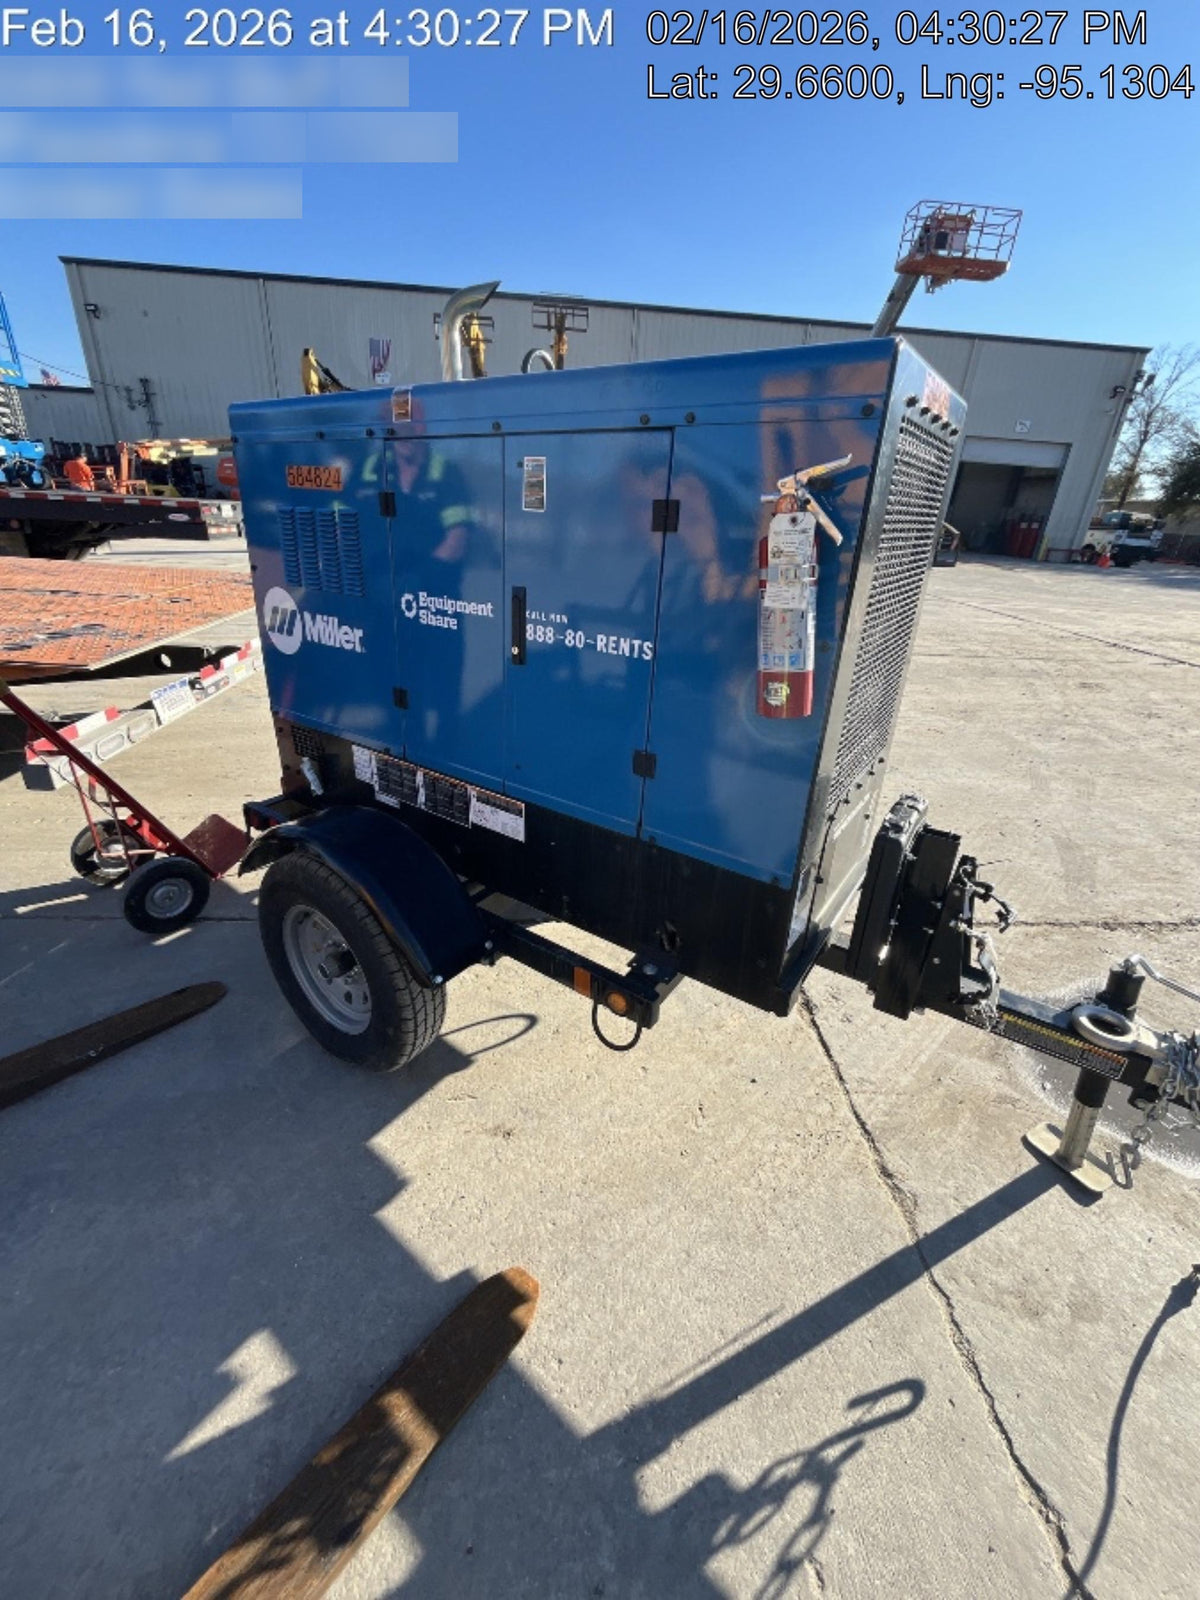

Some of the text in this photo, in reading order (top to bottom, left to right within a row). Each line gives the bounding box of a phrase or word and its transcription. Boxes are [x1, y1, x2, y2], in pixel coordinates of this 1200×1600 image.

[419, 591, 494, 618] Equipment
[303, 611, 363, 653] Miller
[419, 609, 458, 630] Share
